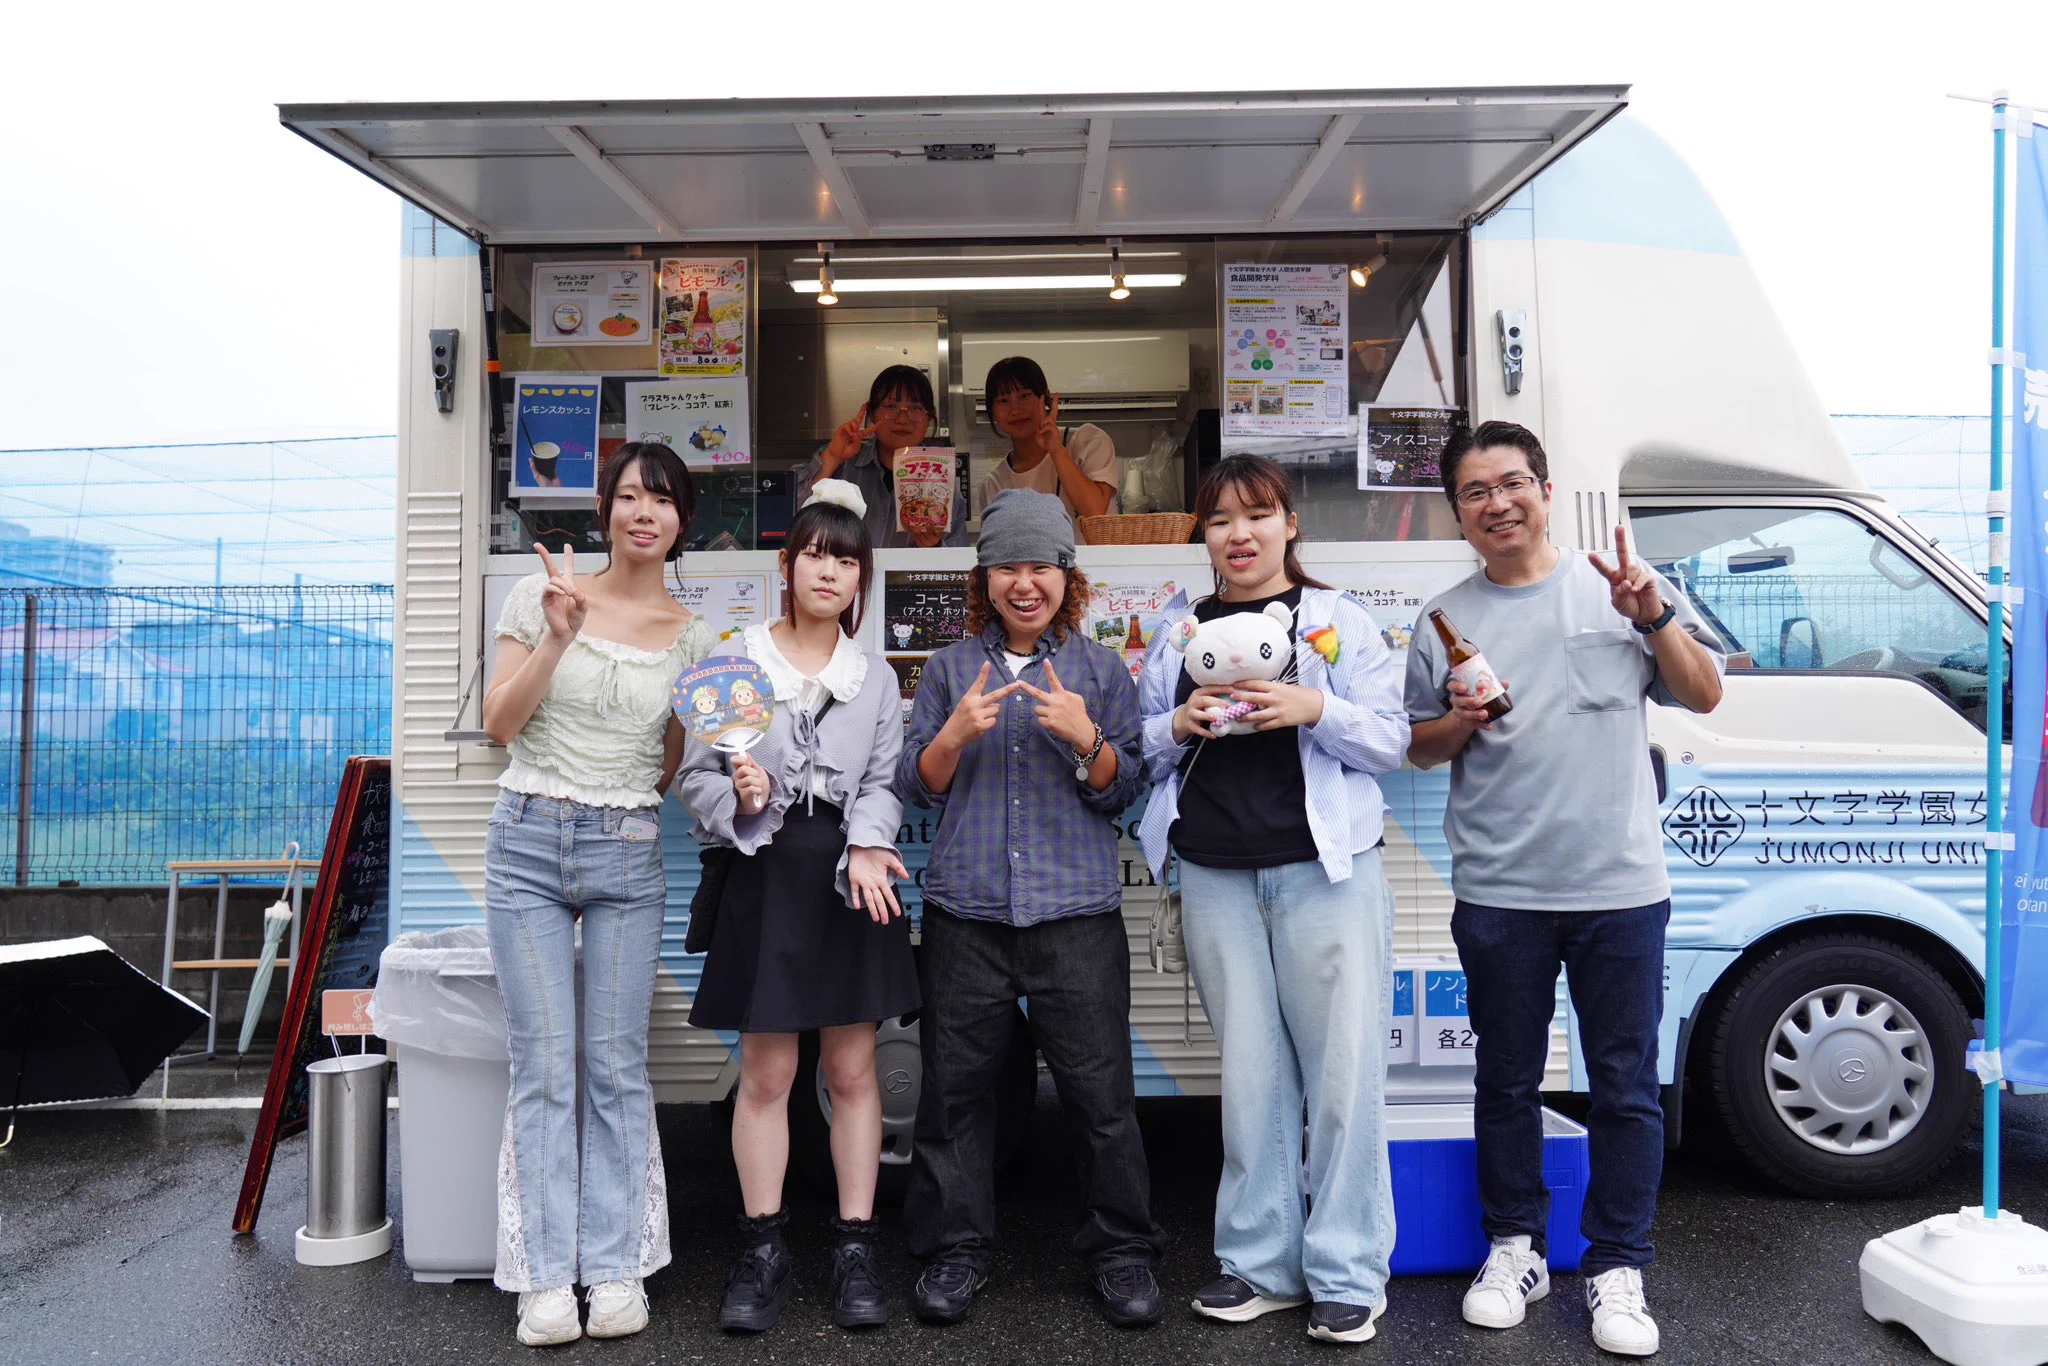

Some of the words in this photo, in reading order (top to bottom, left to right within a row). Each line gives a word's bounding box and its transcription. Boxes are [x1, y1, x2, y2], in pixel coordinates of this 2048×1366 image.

[1230, 274, 1279, 282] 食品開発学科
[522, 405, 592, 415] レモンスカッシュ
[1390, 411, 1453, 419] 十文字学園女子大学
[584, 451, 592, 460] 円
[904, 462, 943, 474] プラス
[915, 593, 963, 604] コーヒー
[1754, 837, 1906, 865] JUMONJI
[1921, 840, 1987, 865] UNI
